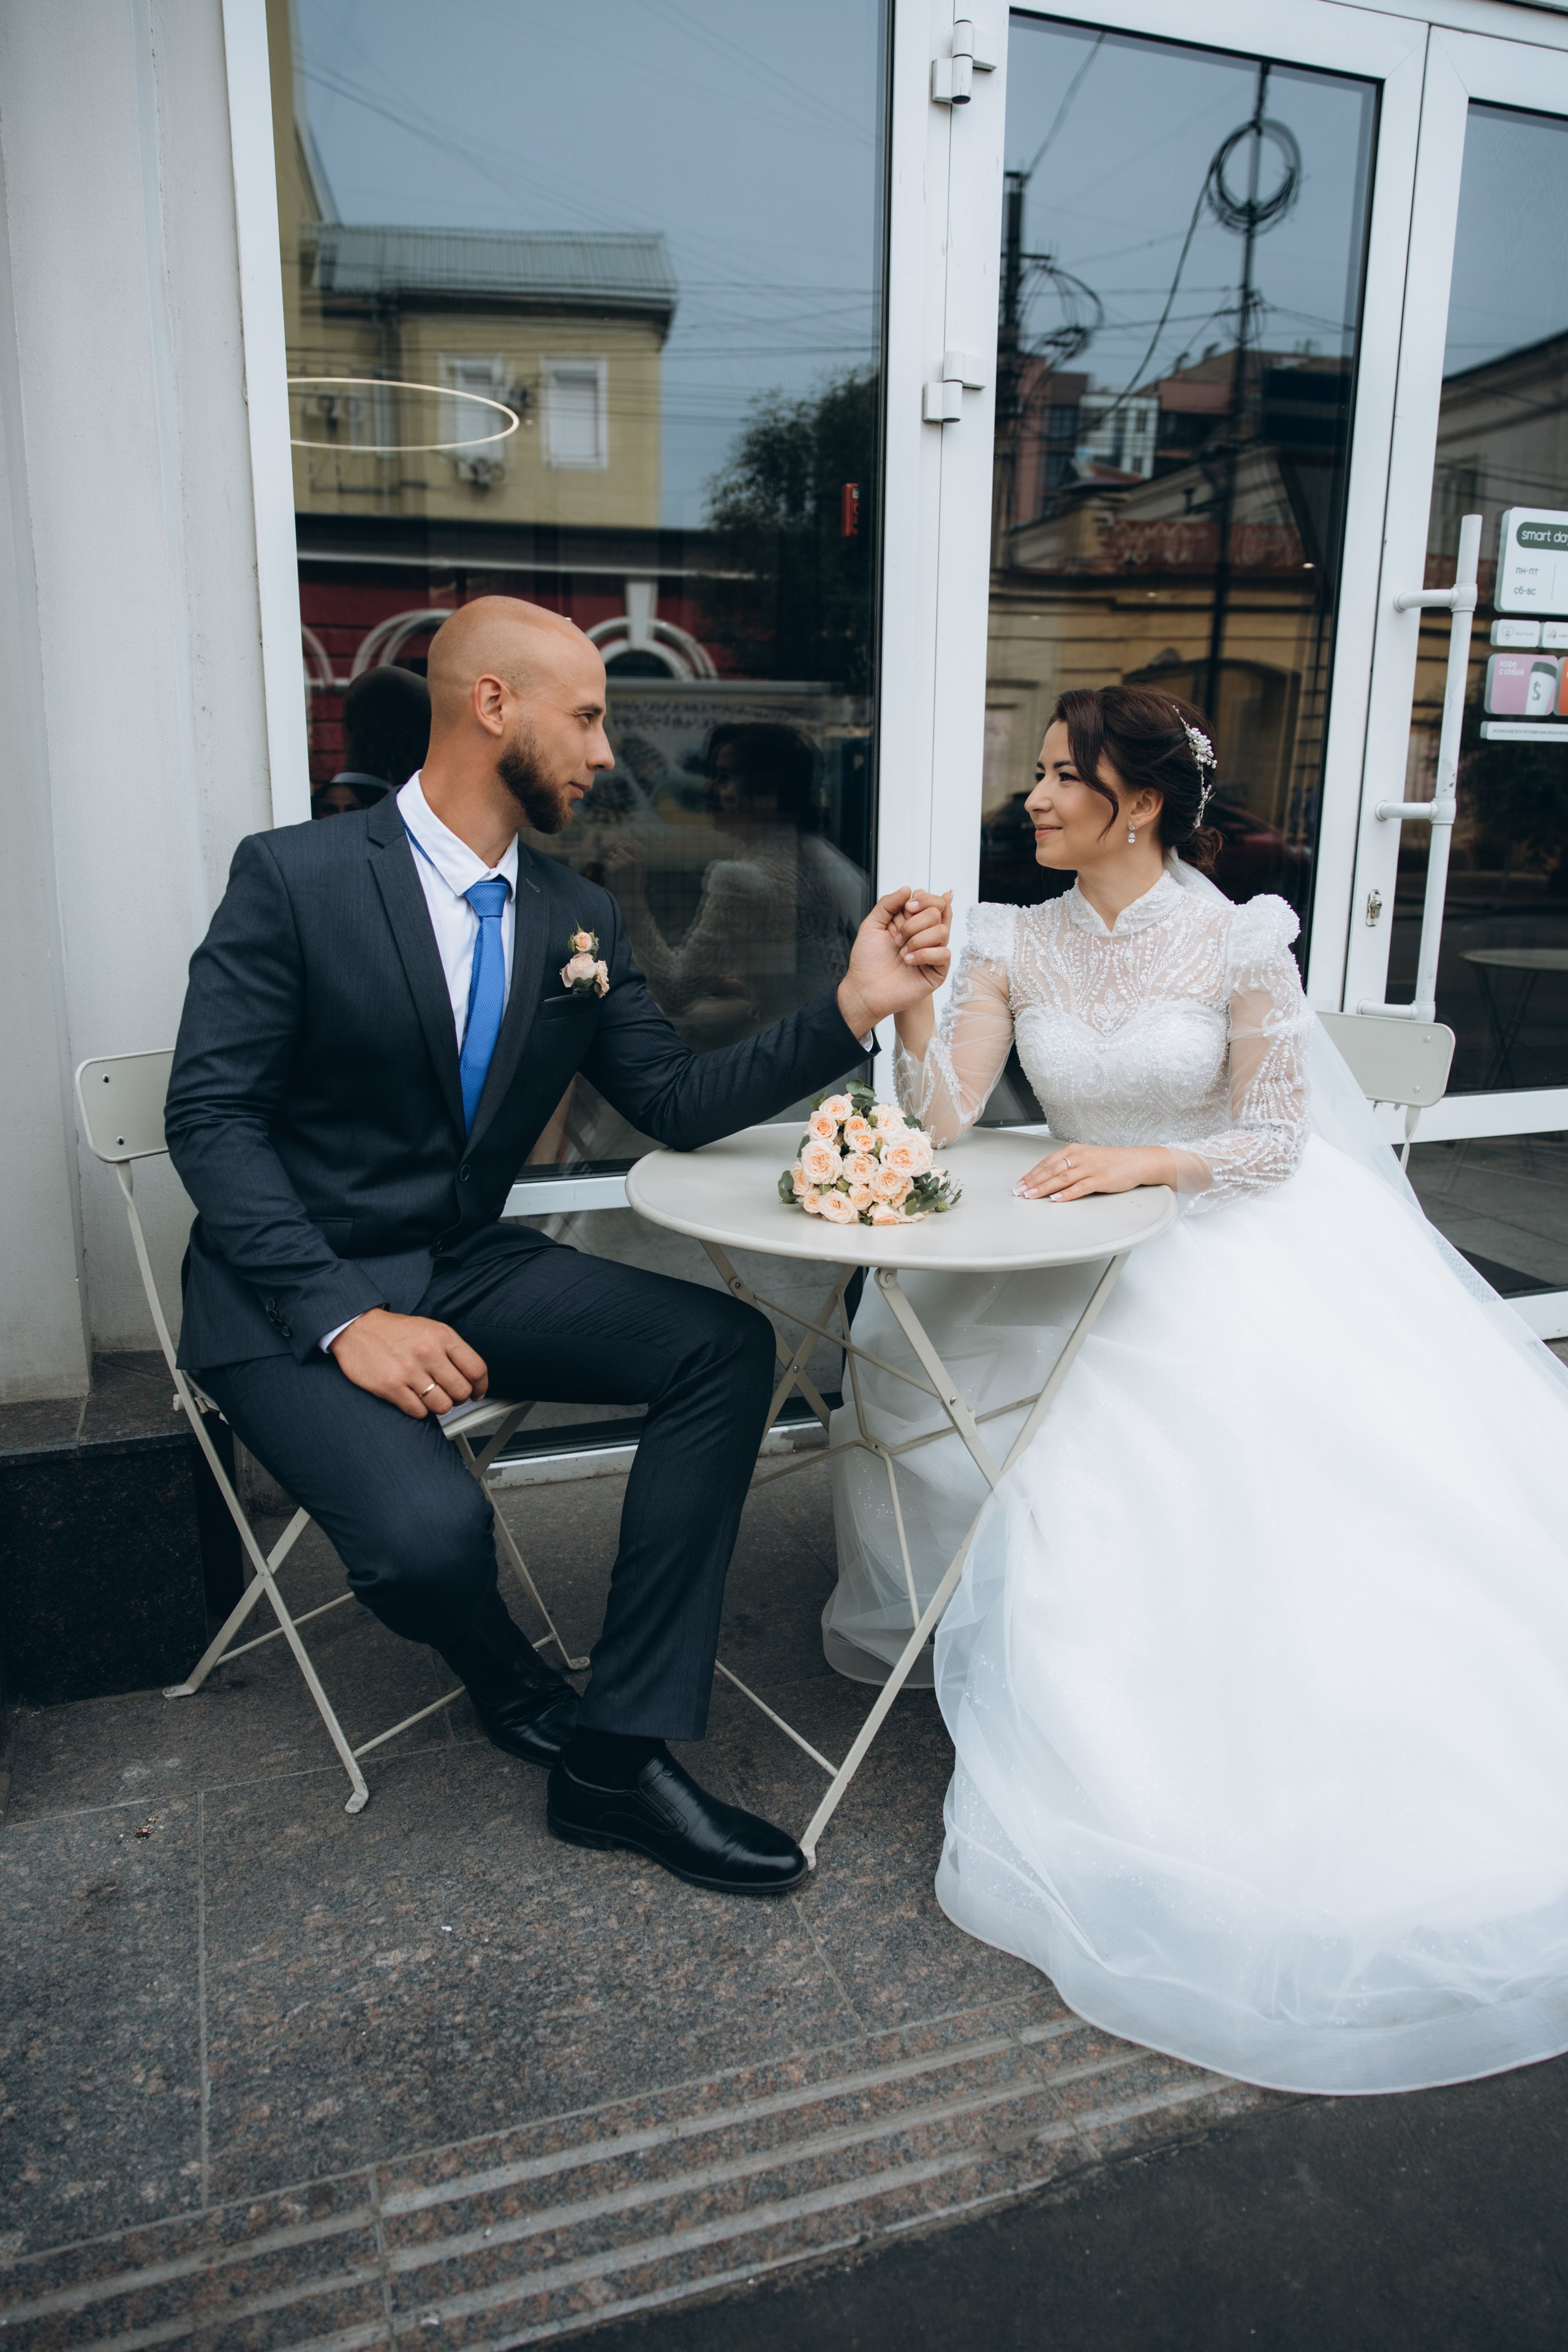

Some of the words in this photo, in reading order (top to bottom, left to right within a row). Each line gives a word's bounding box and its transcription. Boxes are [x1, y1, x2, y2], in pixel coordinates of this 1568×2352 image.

[1521, 530, 1551, 542] smart
[1513, 586, 1536, 595] сб-вс
[1499, 660, 1517, 669] кофе
